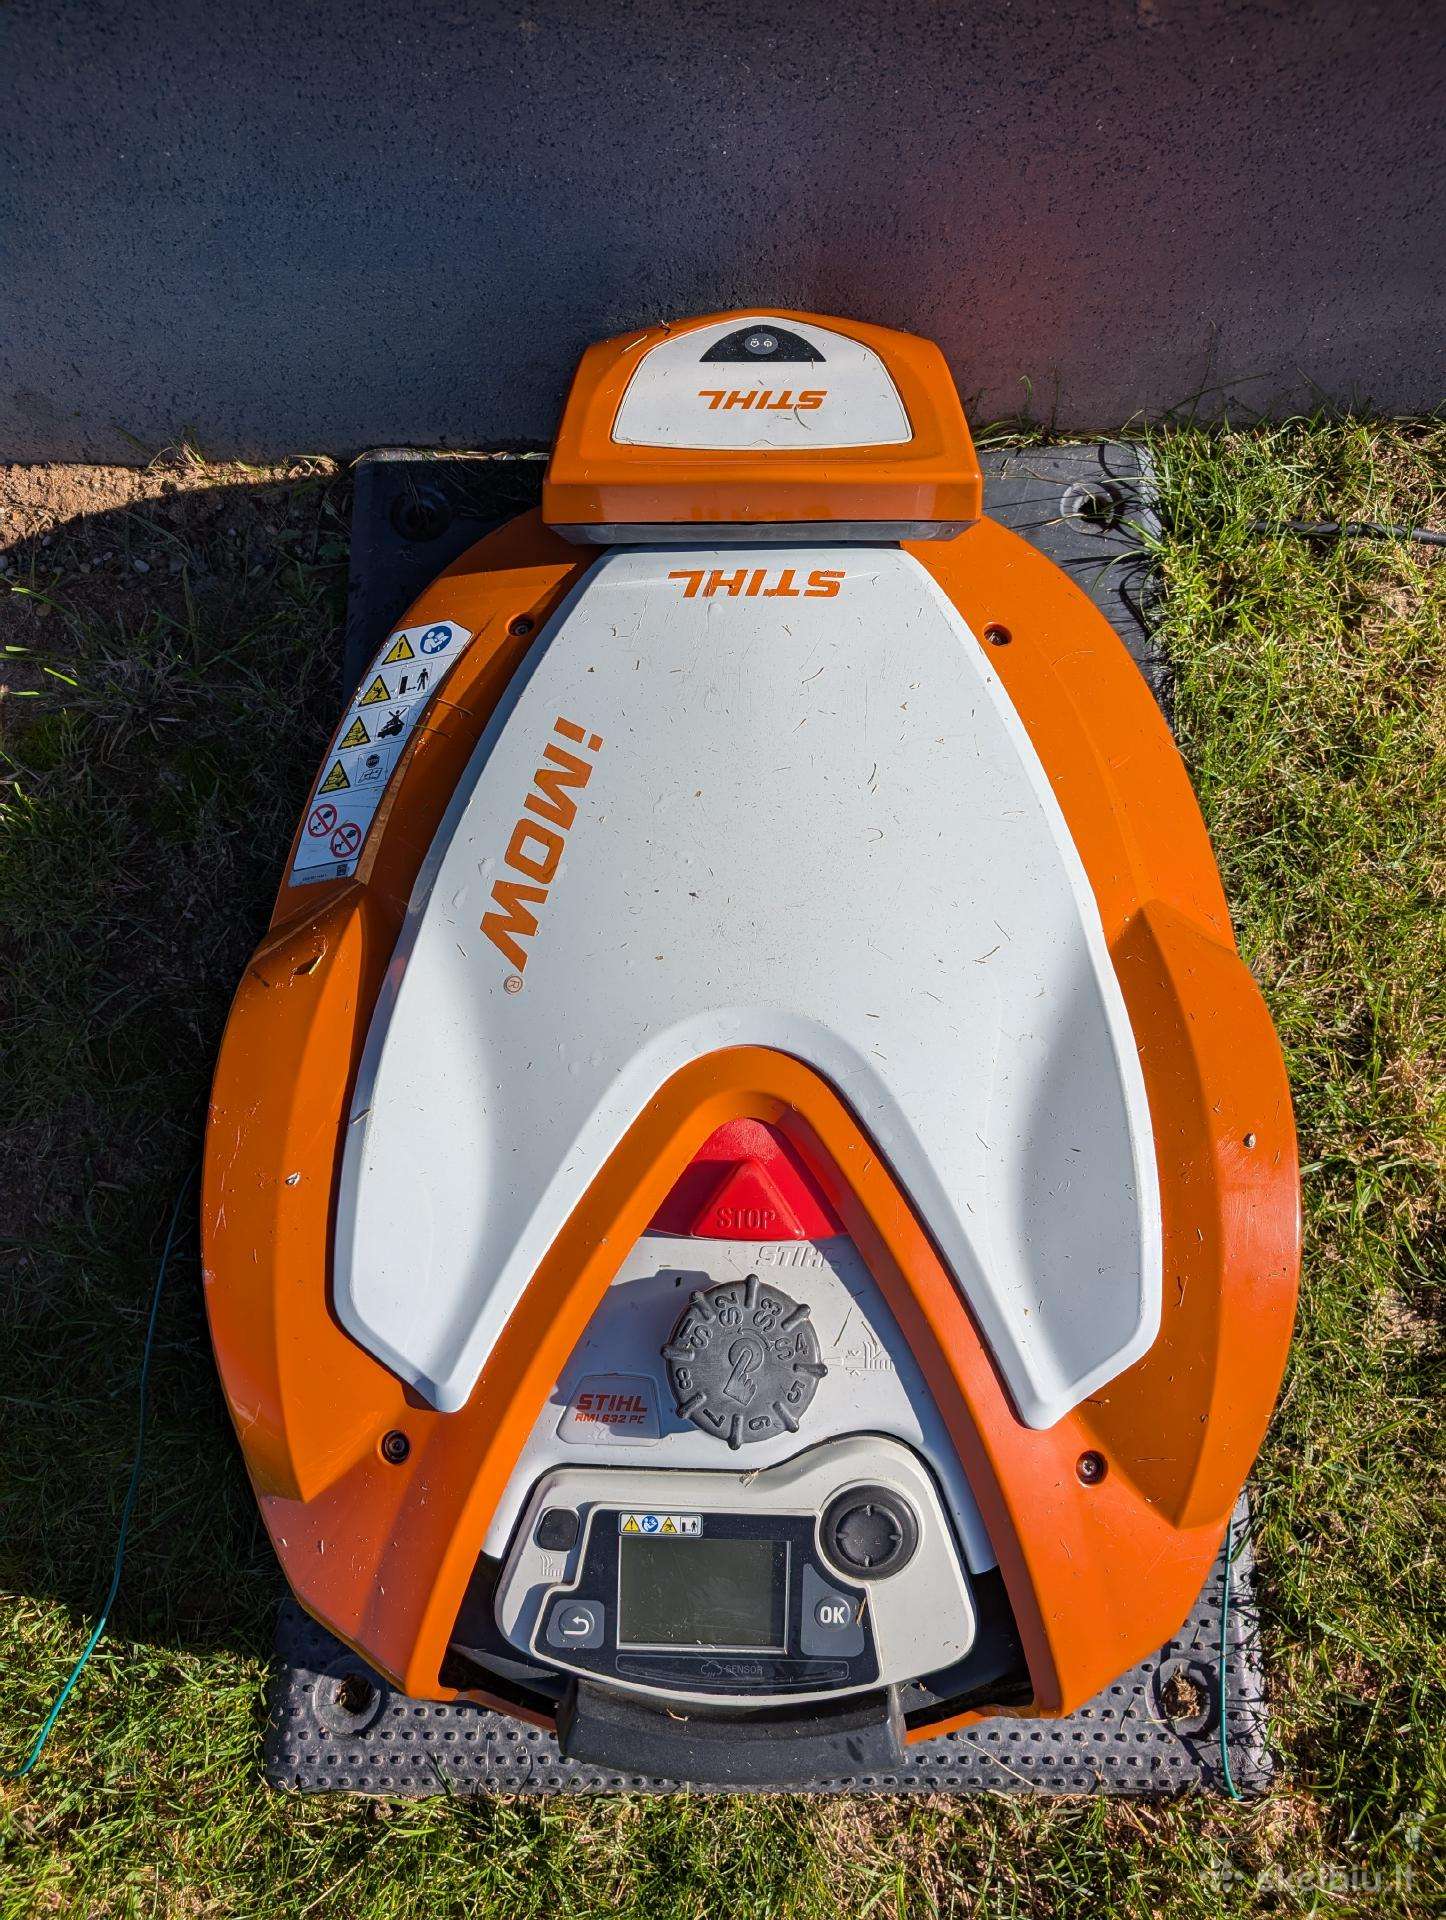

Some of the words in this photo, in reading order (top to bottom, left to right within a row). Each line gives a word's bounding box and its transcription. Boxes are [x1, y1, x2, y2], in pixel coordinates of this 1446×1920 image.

[698, 390, 828, 410] STIHL
[668, 569, 846, 598] STIHL
[717, 1207, 776, 1230] STOP
[714, 1291, 744, 1328] S2
[752, 1297, 784, 1332] S3
[774, 1332, 809, 1361] S4
[675, 1367, 693, 1390] 8
[576, 1393, 648, 1412] STIHL
[786, 1380, 806, 1404] 5
[574, 1412, 600, 1424] RMI
[602, 1414, 627, 1424] 632
[628, 1415, 646, 1425] PC
[702, 1407, 726, 1428] 7
[819, 1605, 846, 1624] OK
[725, 1664, 764, 1675] SENSOR
